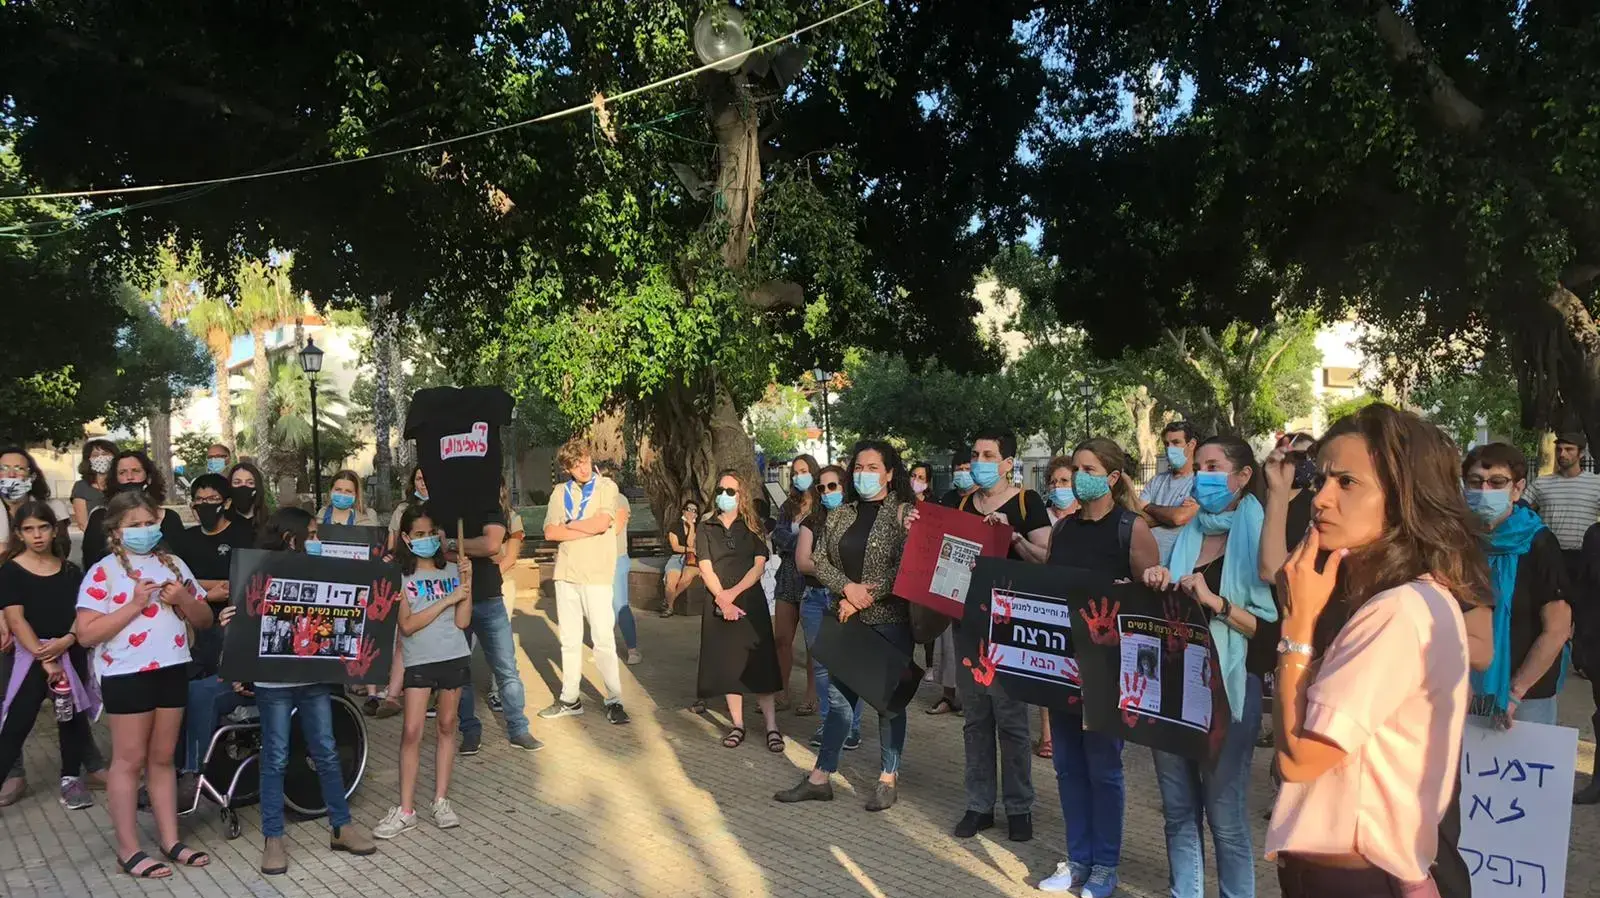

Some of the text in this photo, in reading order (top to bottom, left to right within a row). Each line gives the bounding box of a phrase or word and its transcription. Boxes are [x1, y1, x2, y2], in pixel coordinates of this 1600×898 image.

[325, 585, 353, 605] די!
[269, 603, 361, 617] לרצוח נשים בדם קר
[1033, 606, 1059, 617] וחייבים
[1127, 620, 1147, 631] נשים
[1012, 624, 1066, 651] הרצח
[1030, 656, 1056, 671] הבא
[1465, 752, 1555, 788] דמנו
[1468, 794, 1525, 824] לא
